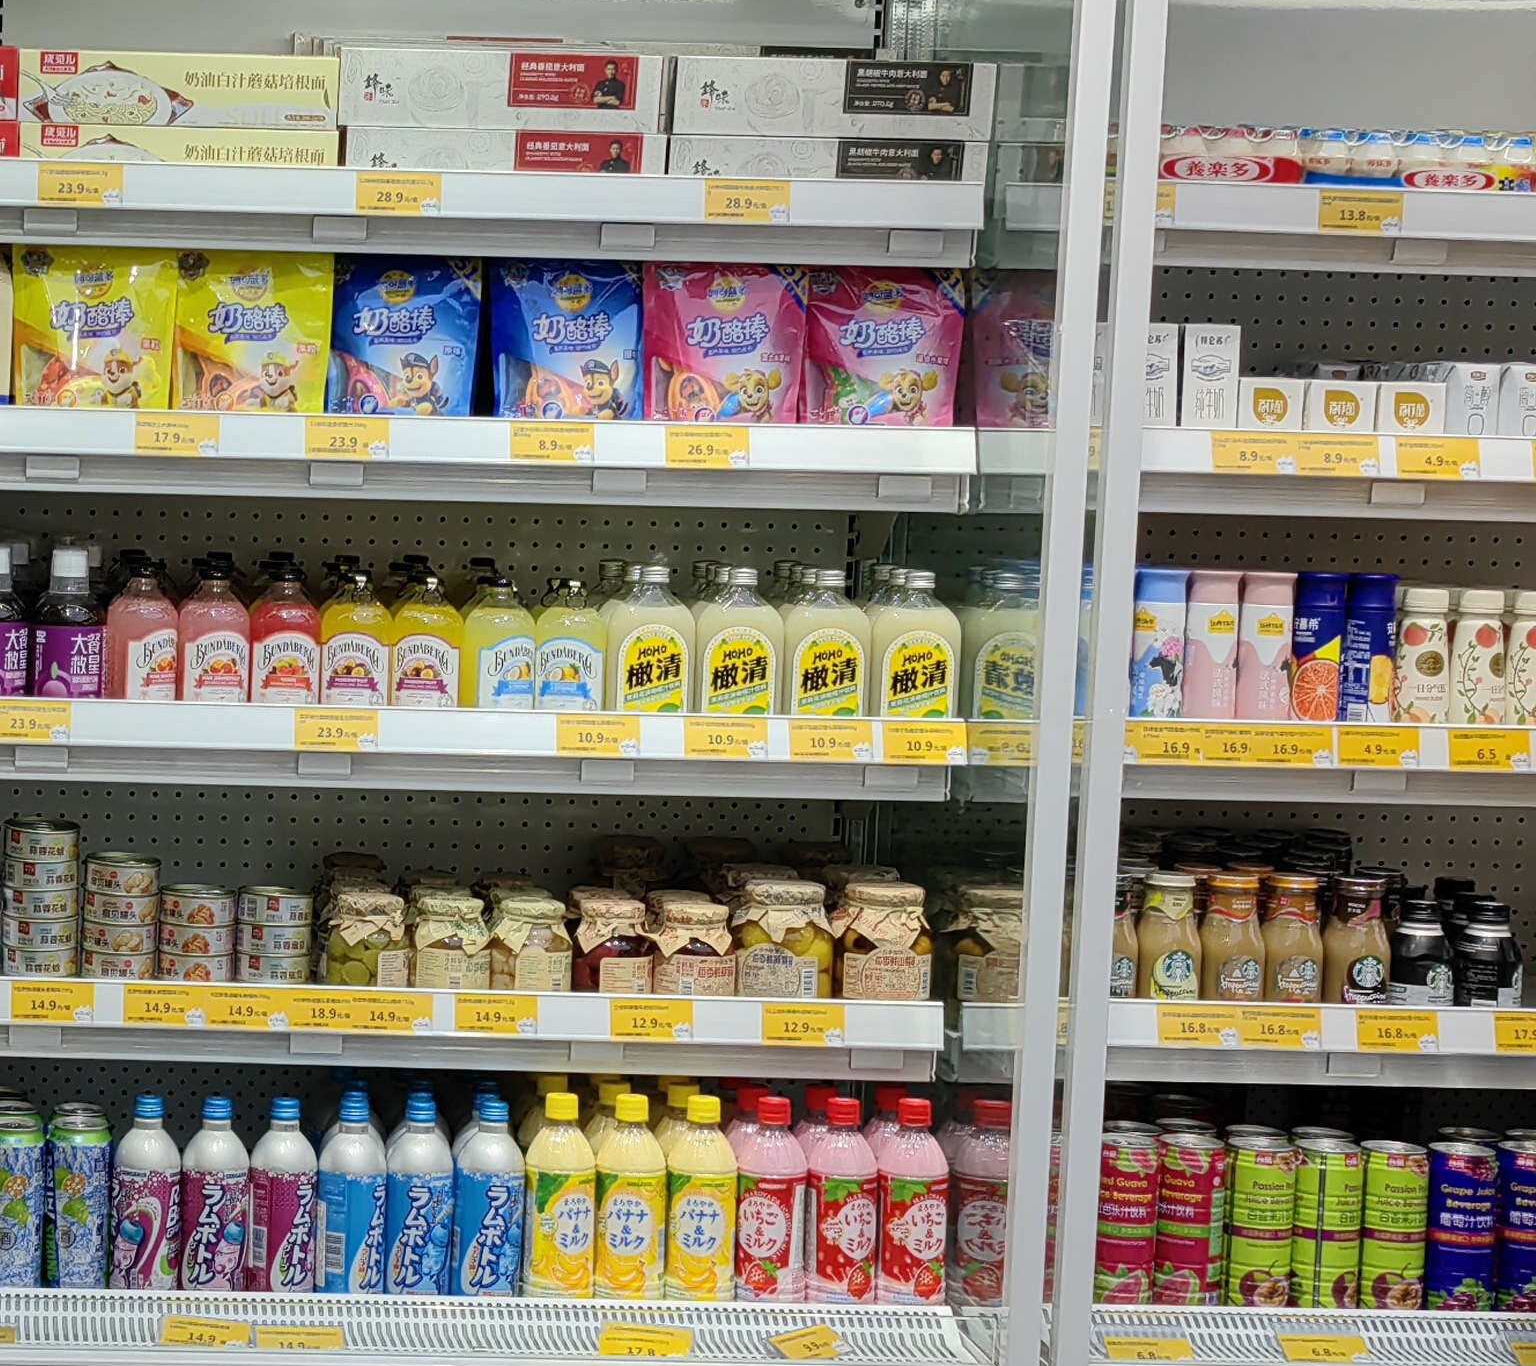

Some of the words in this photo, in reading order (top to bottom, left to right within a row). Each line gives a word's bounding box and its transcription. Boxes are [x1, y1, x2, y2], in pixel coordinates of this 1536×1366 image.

[184, 70, 326, 91] 奶油白汁蘑菇培根面
[184, 143, 325, 164] 奶油白汁蘑菇培根面
[57, 182, 84, 195] 23.9
[376, 191, 403, 203] 28.9
[726, 197, 752, 210] 28.9
[1339, 208, 1366, 221] 13.8
[49, 297, 135, 332] 奶酪棒
[208, 302, 290, 335] 奶酪棒
[353, 305, 435, 336] 奶酪棒
[532, 313, 613, 344] 奶酪棒
[686, 311, 770, 347] 奶酪棒
[838, 315, 927, 348] 奶酪棒
[153, 432, 181, 444] 17.9
[329, 436, 358, 448] 23.9
[538, 439, 558, 451] 8.9
[687, 444, 715, 456] 26.9
[1239, 450, 1259, 462] 8.9
[1323, 452, 1343, 464] 8.9
[1424, 455, 1444, 467] 4.9
[4, 628, 28, 650] 大餐
[70, 633, 102, 655] 大餐
[257, 639, 316, 672] BUNDABERG
[325, 640, 382, 673] BUNDABERG
[393, 641, 452, 676] BUNDABERG
[637, 645, 668, 660] HOHO
[721, 647, 754, 663] HOHO
[812, 648, 843, 665] HOHO
[902, 650, 934, 666] HOHO
[4, 649, 28, 671] 救星
[70, 655, 101, 676] 救星
[537, 645, 592, 679] BUNDABERG
[625, 653, 682, 691] 橄清
[710, 655, 768, 692] 橄清
[801, 657, 858, 694] 橄清
[890, 660, 948, 696] 橄清
[9, 718, 37, 730] 23.9
[316, 727, 343, 739] 23.9
[577, 732, 604, 744] 10.9
[707, 733, 734, 746] 10.9
[809, 736, 835, 749] 10.9
[906, 740, 933, 753] 10.9
[1162, 741, 1190, 754] 16.9
[1222, 742, 1248, 754] 16.9
[1272, 743, 1299, 756] 16.9
[1477, 748, 1497, 761] 6.5
[30, 999, 57, 1011] 14.9
[144, 1002, 171, 1013] 14.9
[228, 1005, 254, 1017] 14.9
[310, 1008, 337, 1020] 18.9
[369, 1010, 396, 1022] 14.9
[475, 1012, 502, 1023] 14.9
[631, 1017, 658, 1029] 12.9
[782, 1022, 810, 1033] 12.9
[1180, 1021, 1207, 1034] 16.8
[1260, 1023, 1286, 1036] 16.8
[1377, 1027, 1403, 1039] 16.8
[1116, 1177, 1148, 1188] Guava
[1165, 1176, 1195, 1188] Guava
[1253, 1180, 1285, 1191] Passion
[1384, 1184, 1417, 1195] Passion
[1440, 1183, 1474, 1196] Grape
[1376, 1197, 1400, 1207] Juice
[1446, 1198, 1491, 1210] Beverage
[558, 1207, 591, 1221] バナナ
[608, 1208, 649, 1224] バナナ
[679, 1209, 720, 1226] バナナ
[742, 1208, 777, 1227] いちご
[844, 1212, 872, 1229] いちご
[912, 1212, 945, 1227] いちご
[188, 1183, 226, 1285] ラムボトル
[394, 1185, 433, 1288] ラムボトル
[468, 1184, 511, 1287] ラムボトル
[560, 1233, 589, 1248] ミルク
[609, 1234, 645, 1249] ミルク
[681, 1235, 717, 1249] ミルク
[743, 1236, 777, 1250] ミルク
[845, 1238, 872, 1251] ミルク
[913, 1237, 943, 1251] ミルク
